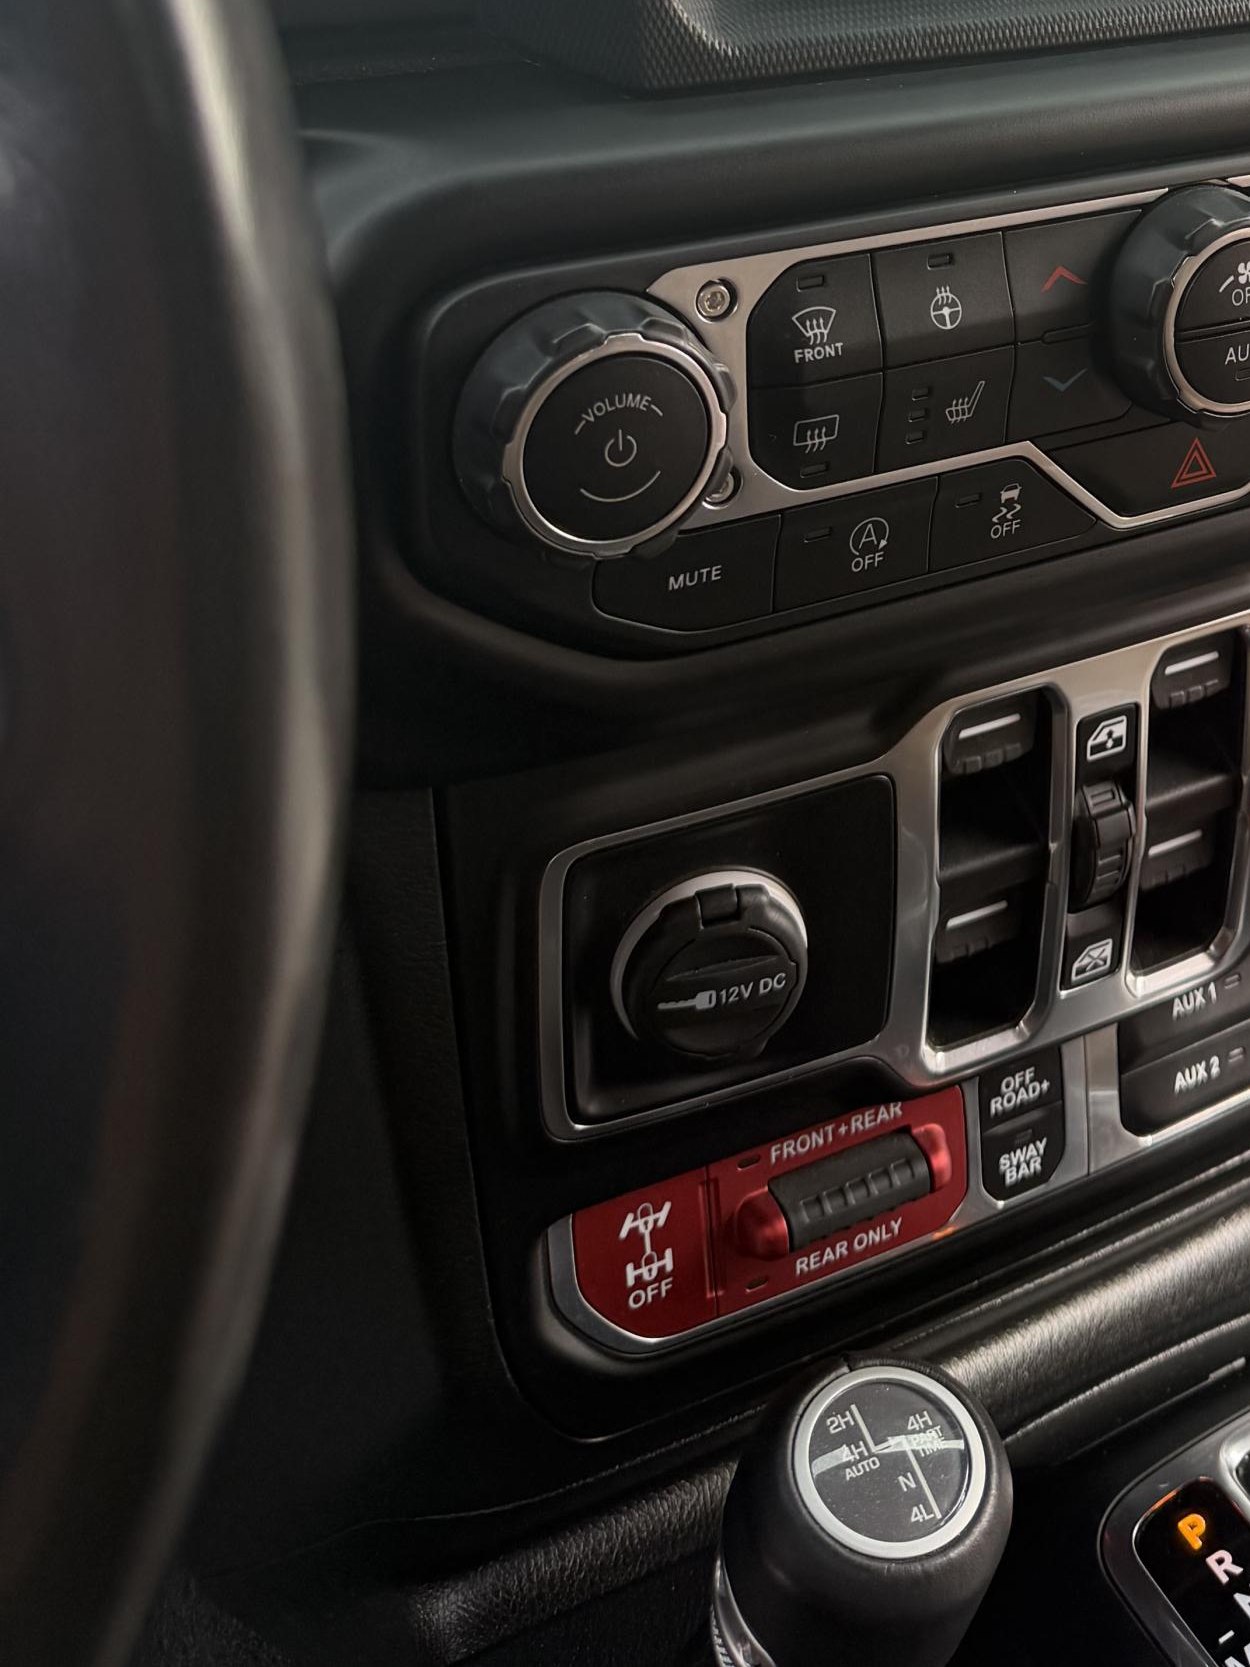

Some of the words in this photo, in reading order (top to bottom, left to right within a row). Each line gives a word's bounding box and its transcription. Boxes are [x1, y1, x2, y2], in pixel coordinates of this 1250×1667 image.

[794, 342, 843, 363] FRONT
[580, 393, 652, 424] VOLUME
[990, 519, 1021, 539] OFF
[851, 551, 884, 573] OFF
[668, 565, 723, 591] MUTE
[720, 981, 754, 1005] 12V
[759, 972, 786, 995] DC
[1172, 987, 1206, 1021] AUX
[1207, 981, 1217, 1004] 1
[1000, 1066, 1035, 1093] OFF
[1174, 1060, 1208, 1095] AUX
[1208, 1055, 1220, 1079] 2
[990, 1079, 1050, 1118] ROAD+
[999, 1137, 1047, 1174] SWAY
[1005, 1156, 1042, 1187] BAR
[795, 1240, 848, 1275] REAR
[853, 1217, 902, 1252] ONLY
[628, 1278, 673, 1310] OFF
[826, 1410, 855, 1434] 2H
[907, 1410, 933, 1431] 4H
[842, 1440, 869, 1462] 4H
[844, 1457, 881, 1481] AUTO
[897, 1472, 917, 1492] N
[910, 1504, 934, 1523] 4L
[1177, 1513, 1206, 1551] P
[1205, 1549, 1243, 1585] R
